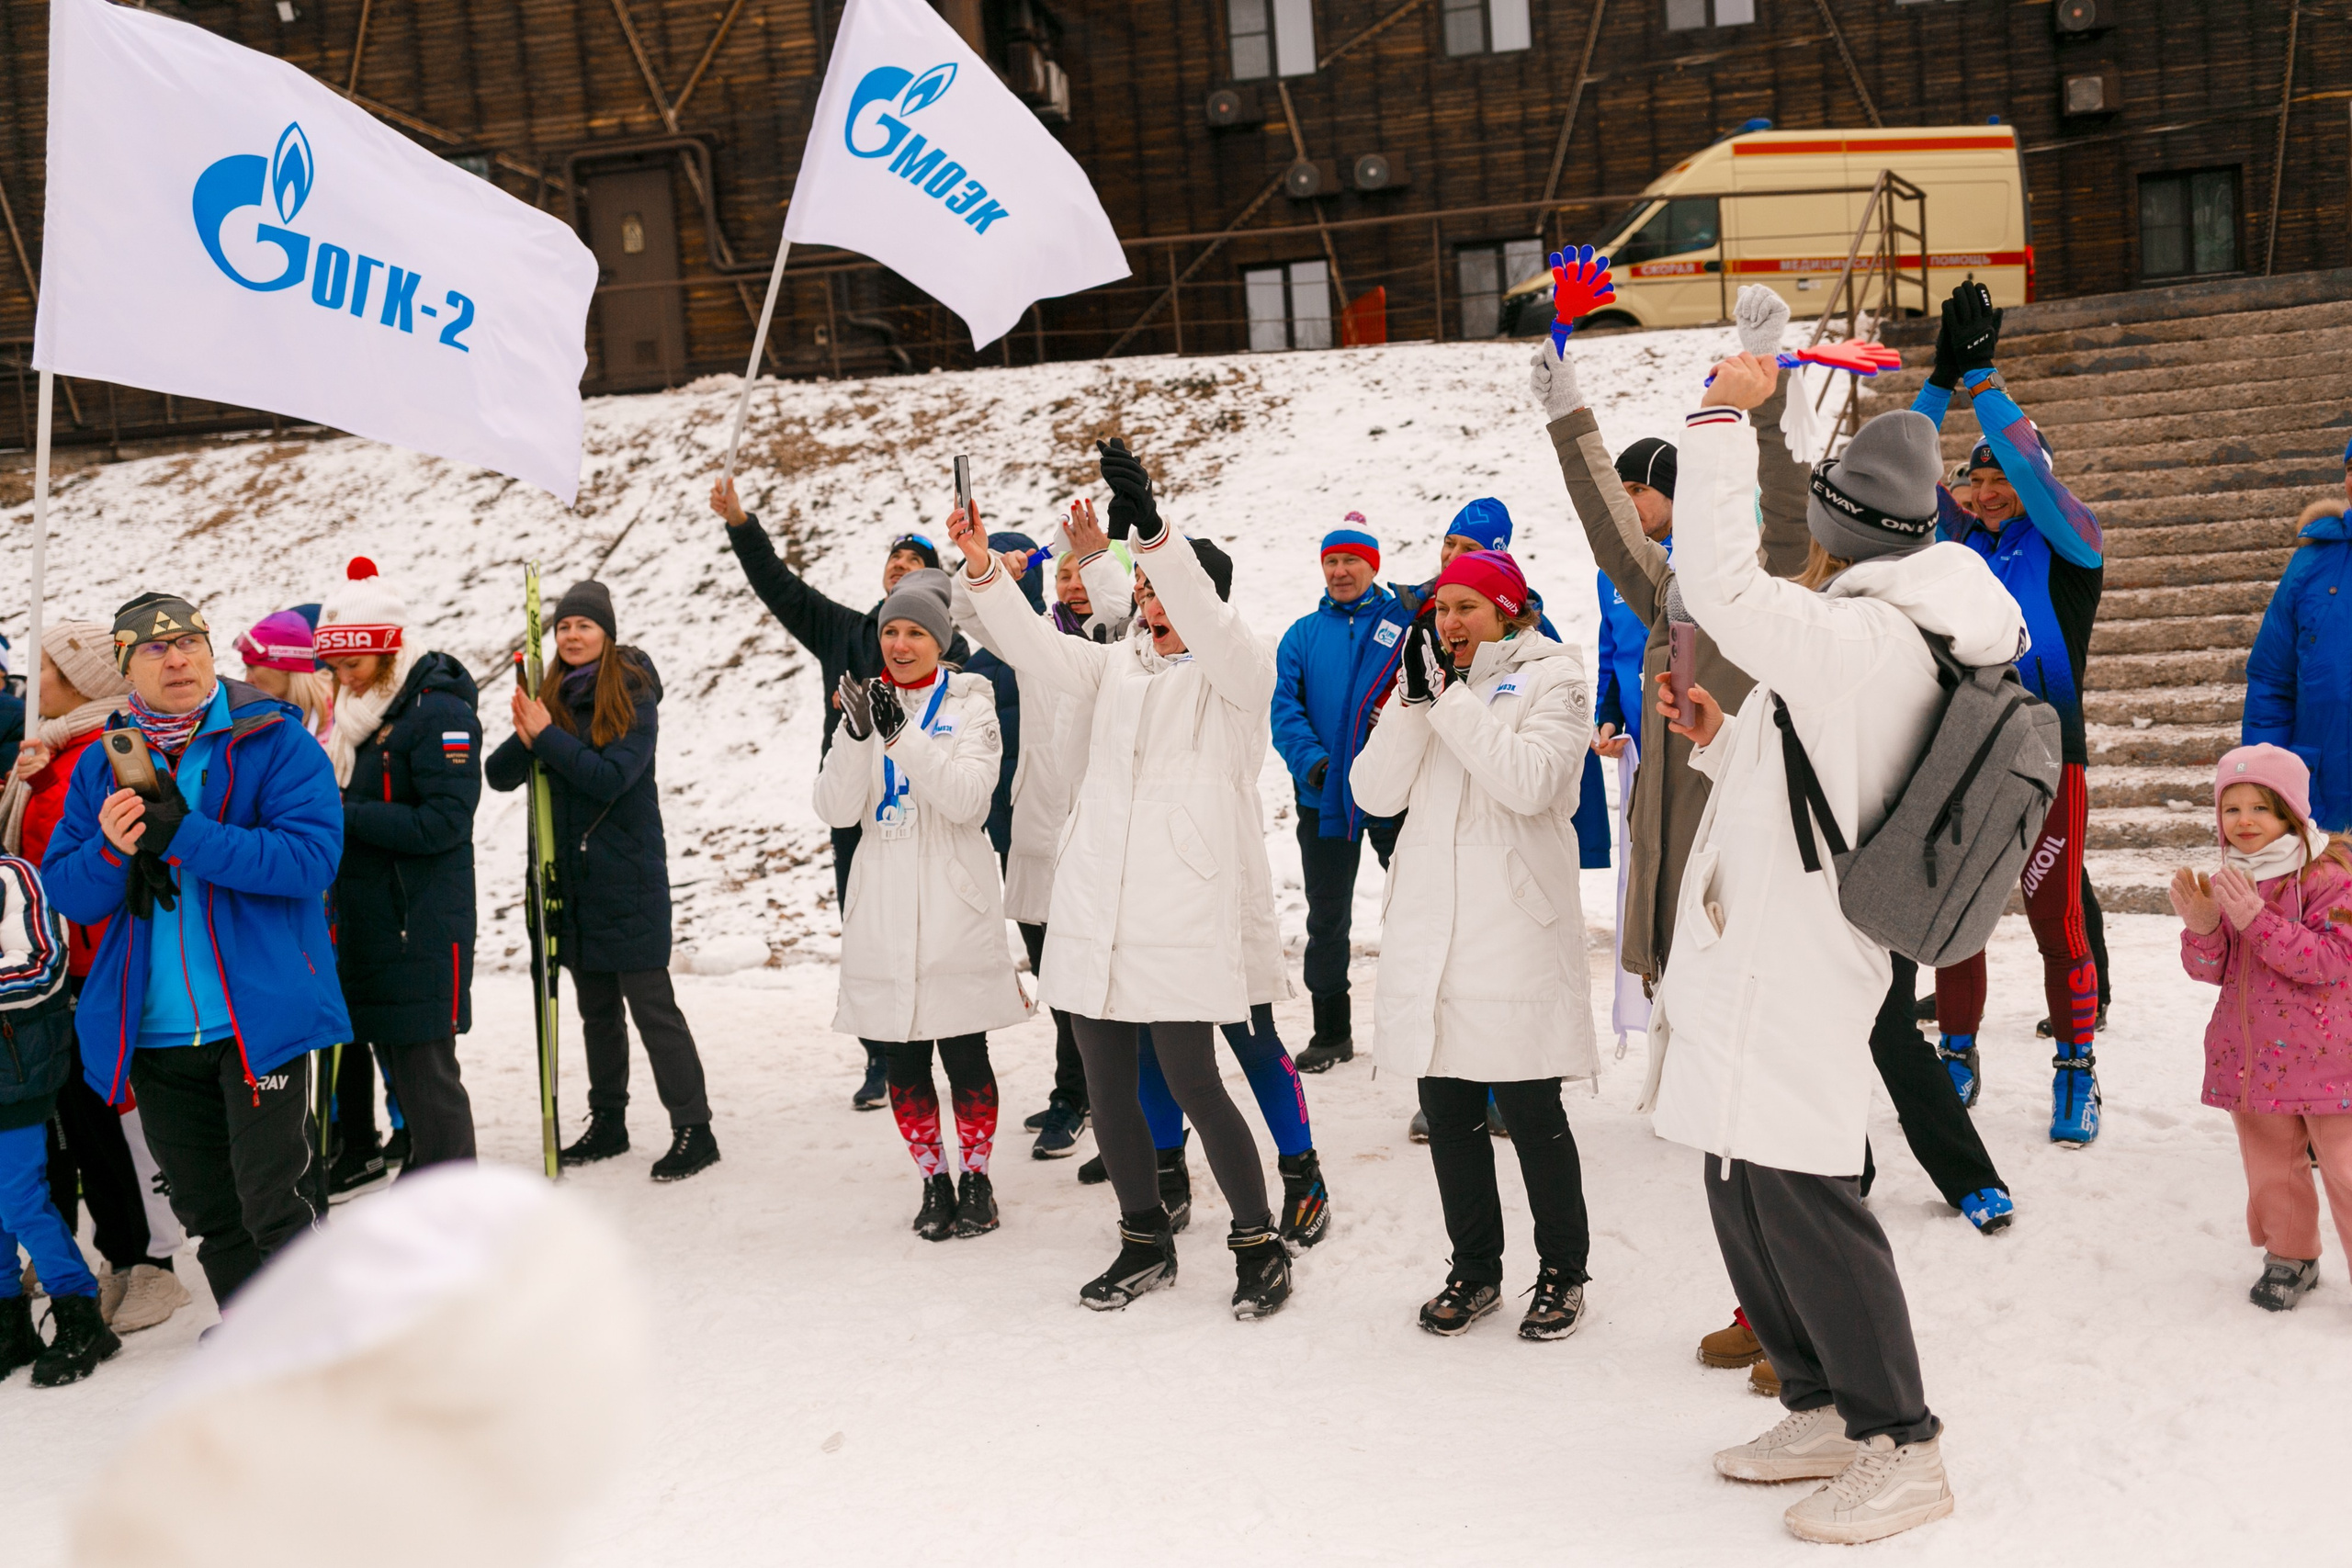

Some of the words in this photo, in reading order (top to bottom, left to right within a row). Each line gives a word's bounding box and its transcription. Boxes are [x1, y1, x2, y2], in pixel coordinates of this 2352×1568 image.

[888, 133, 1010, 235] МОЭК
[1640, 262, 1695, 276] СКОРАЯ
[1929, 254, 1992, 267] ПОМОЩЬ
[311, 243, 475, 353] ОГК-2
[1981, 289, 1990, 306] LEKI
[1967, 333, 1988, 349] LEKI
[313, 631, 372, 650] USSIA
[2023, 835, 2066, 899] LUKOIL
[257, 1075, 289, 1091] RAY
[1280, 1054, 1308, 1124] SPINE
